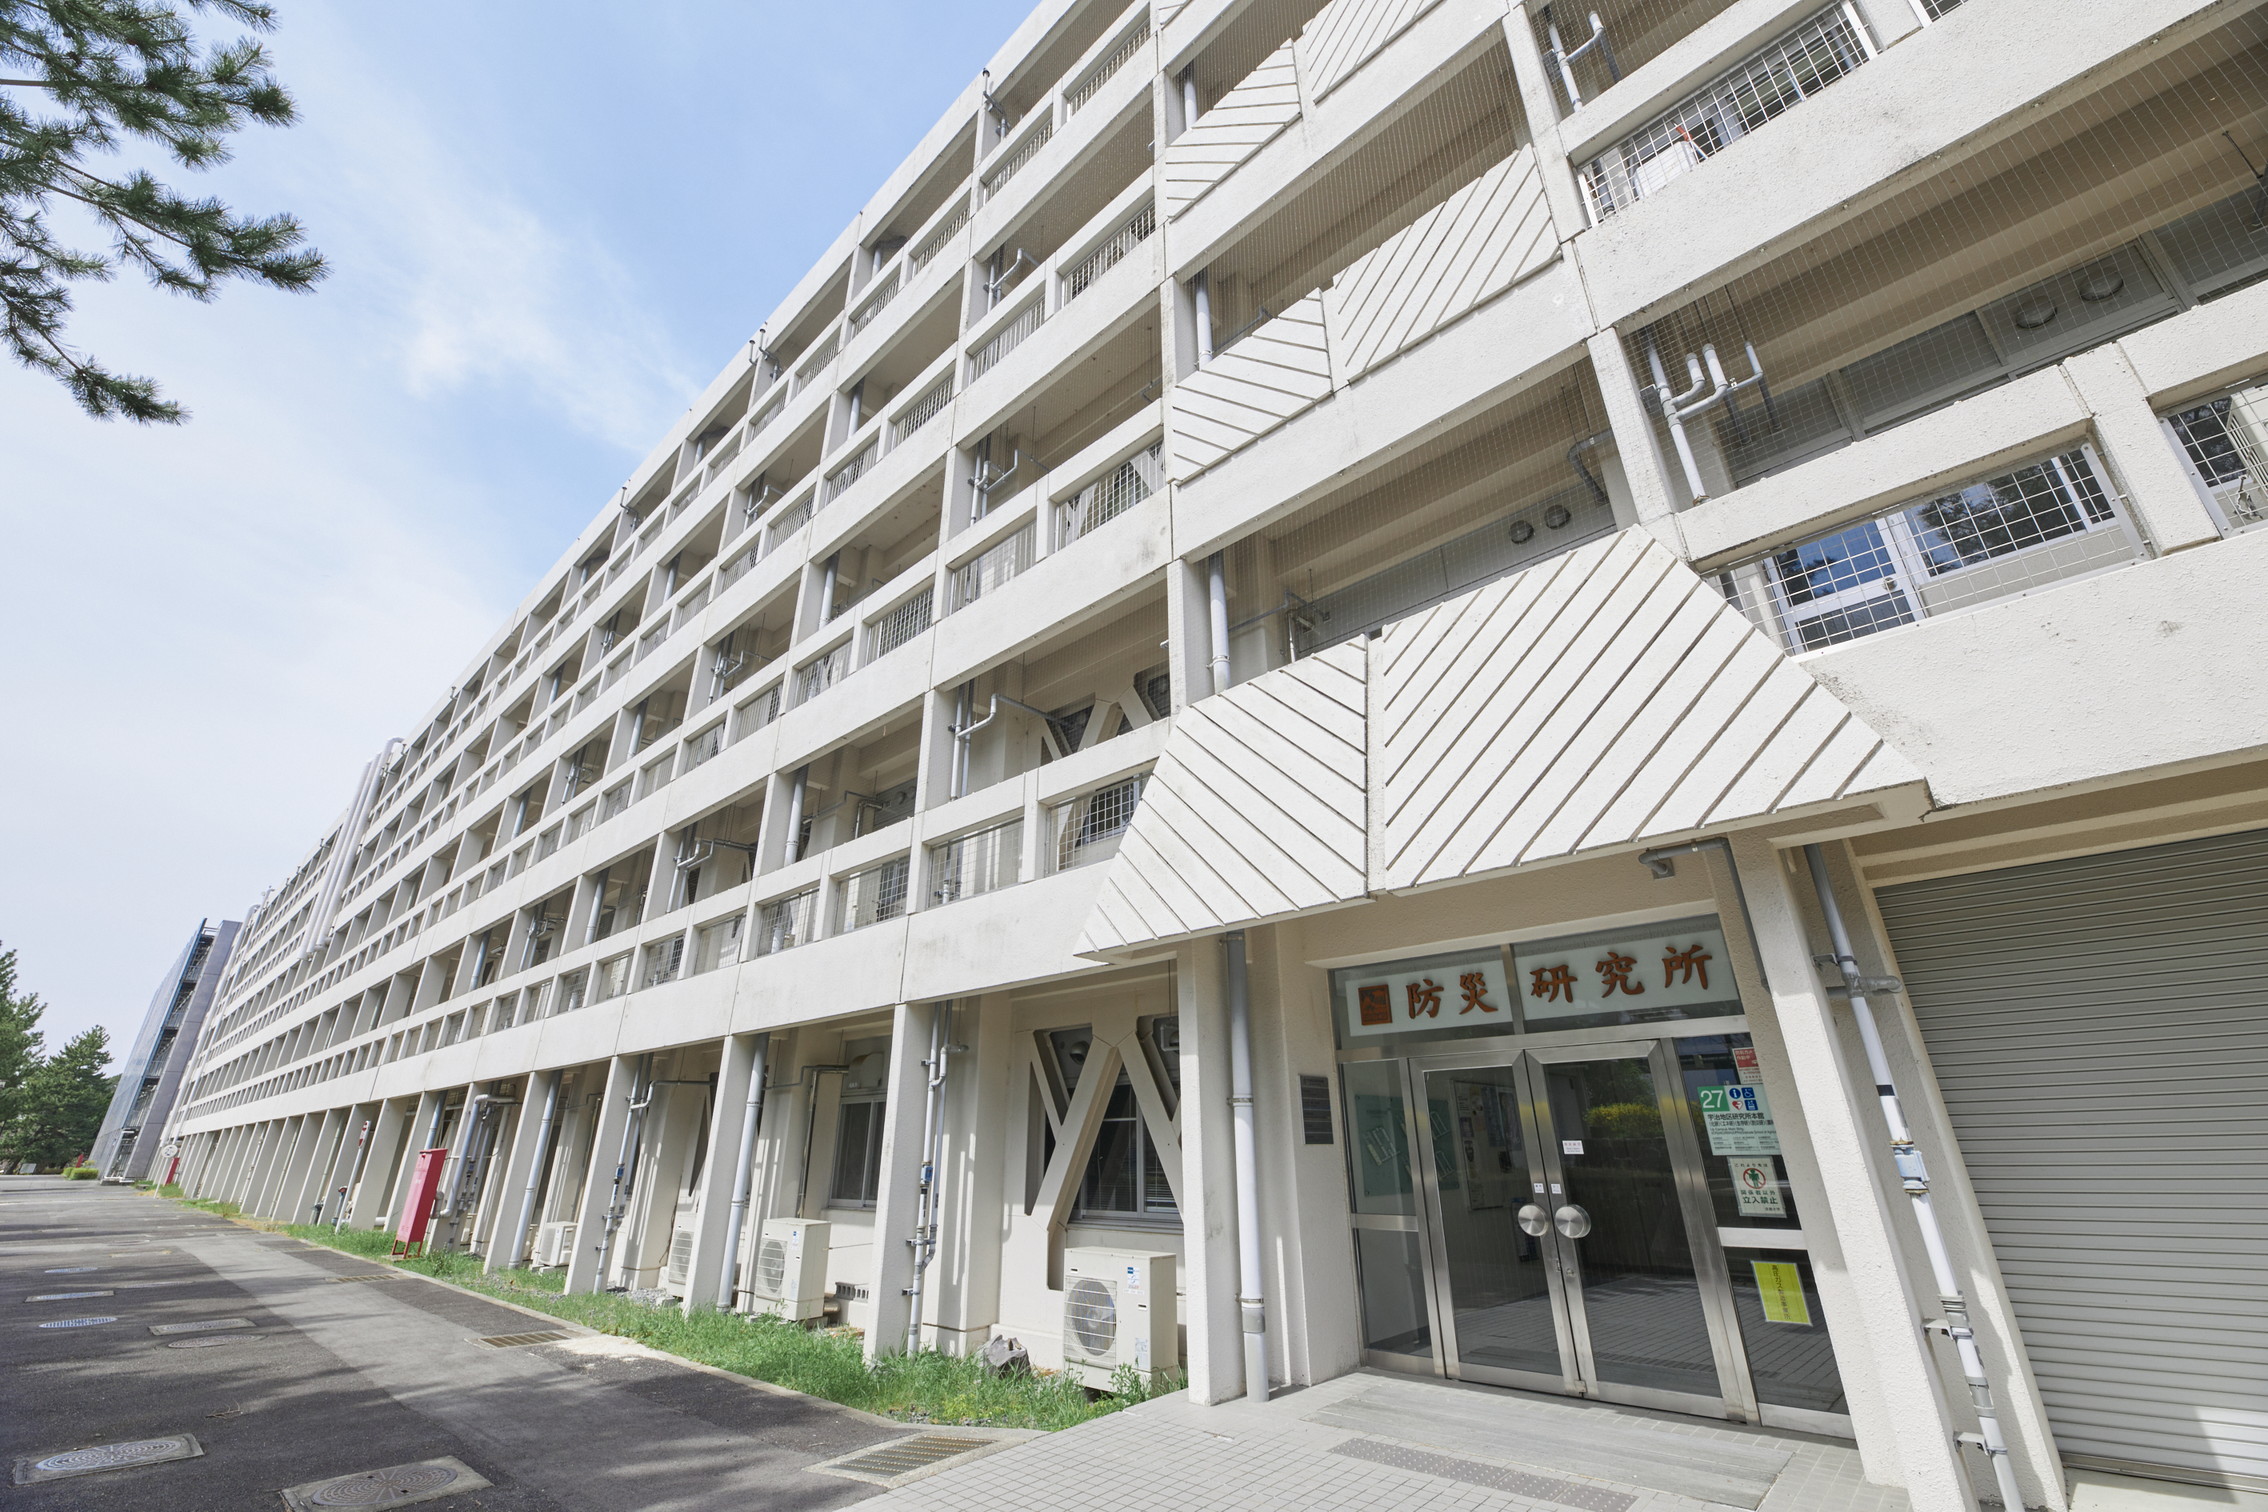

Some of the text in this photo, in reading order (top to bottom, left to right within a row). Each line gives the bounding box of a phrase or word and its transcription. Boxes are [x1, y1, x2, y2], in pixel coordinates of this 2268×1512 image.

[1406, 944, 1713, 1020] 防災研究所
[1700, 1089, 1723, 1108] 27
[1742, 1196, 1778, 1205] 立入禁止
